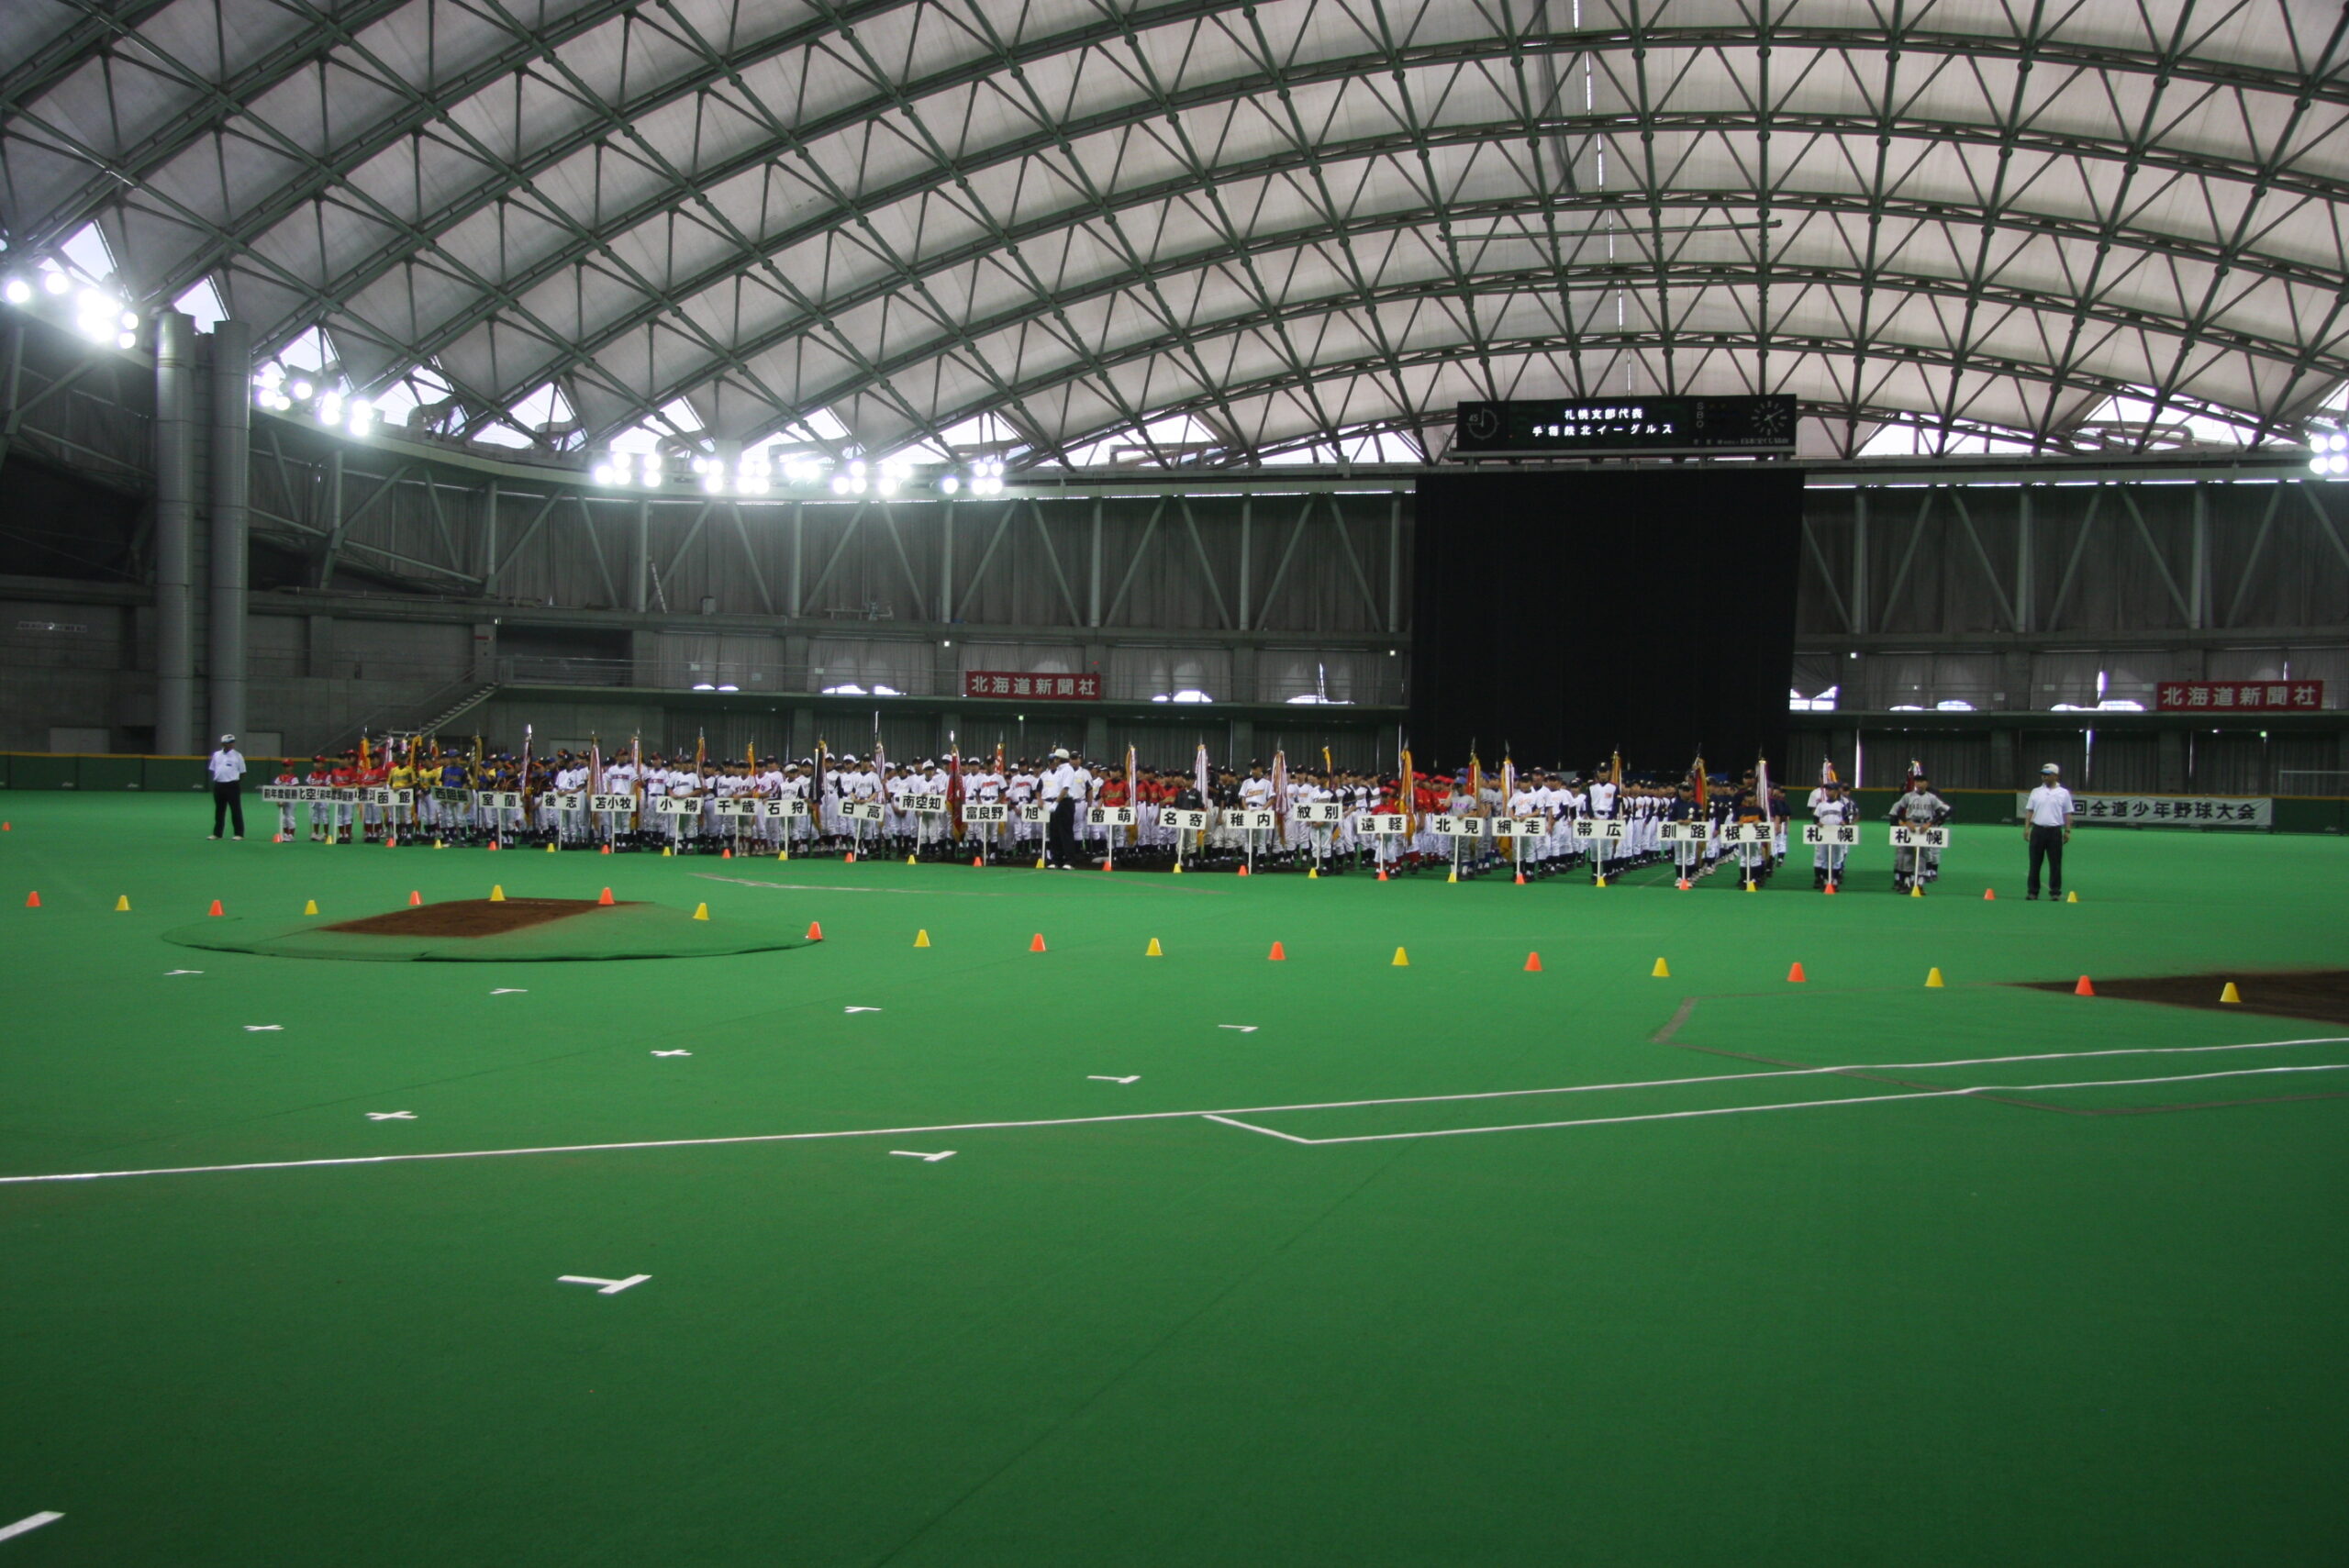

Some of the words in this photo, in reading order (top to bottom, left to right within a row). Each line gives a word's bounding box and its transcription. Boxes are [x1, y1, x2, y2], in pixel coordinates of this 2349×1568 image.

[971, 675, 1096, 695] 北海道新聞社
[2162, 685, 2316, 706] 北海道新聞社
[377, 791, 411, 805] 函館
[482, 794, 517, 807] 室蘭
[545, 795, 577, 807] 後志
[595, 797, 631, 810] 苫小牧
[660, 798, 698, 812] 小樽
[903, 795, 941, 810] 南空知
[718, 800, 755, 813] 千歳
[768, 802, 804, 815] 石狩
[842, 802, 881, 818] 日高
[966, 806, 1004, 819] 富良野
[1297, 806, 1339, 819] 紋別
[1092, 808, 1131, 823] 留萌
[1163, 811, 1202, 827] 名寄
[1230, 813, 1270, 827] 稚内
[1361, 817, 1403, 831] 遠軽
[1436, 817, 1479, 834] 北見
[1497, 820, 1540, 834] 網走
[1577, 822, 1621, 837] 帯広
[1661, 825, 1706, 839] 釧路
[1725, 826, 1771, 840] 根室
[1807, 827, 1854, 842] 札幌
[1895, 828, 1943, 844] 札幌
